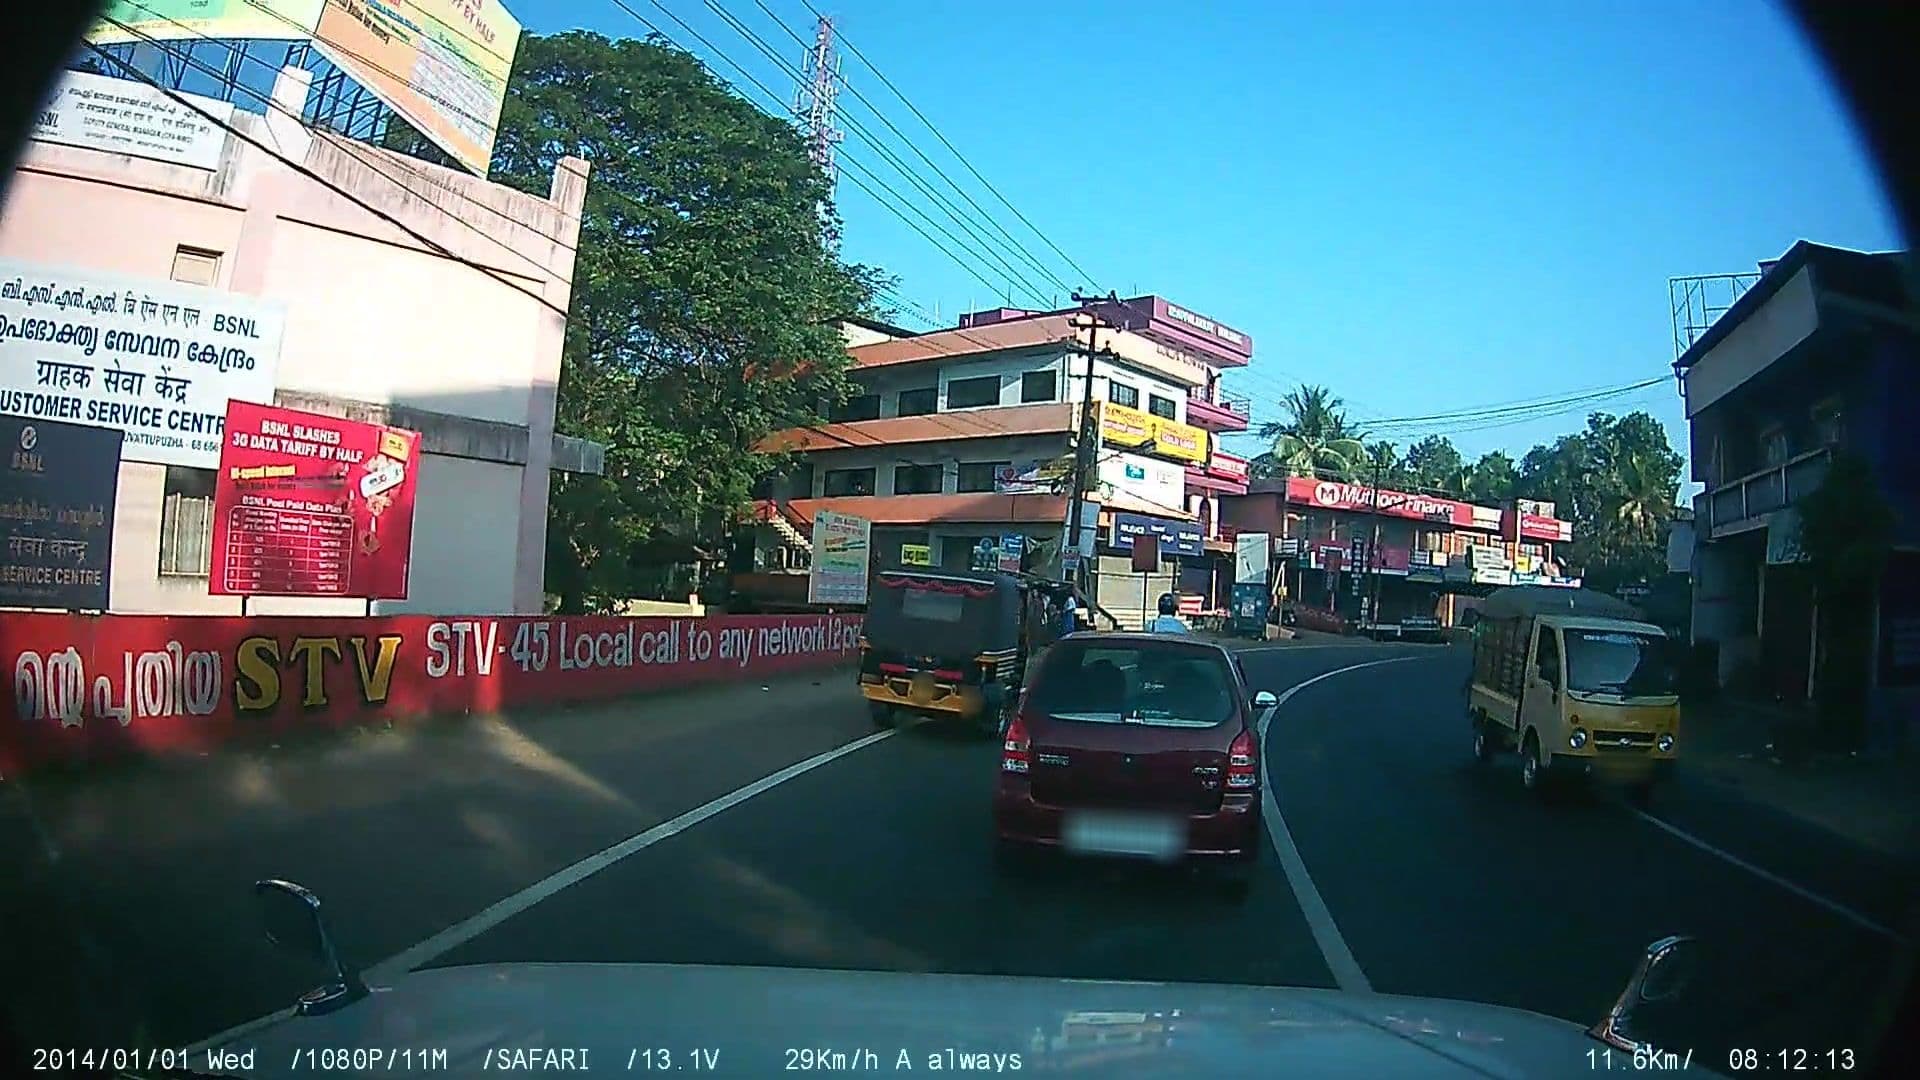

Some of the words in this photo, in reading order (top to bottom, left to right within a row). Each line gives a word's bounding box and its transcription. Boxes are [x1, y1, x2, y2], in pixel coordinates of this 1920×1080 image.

[213, 313, 260, 339] BSNL
[104, 329, 181, 360] സേവന
[36, 359, 94, 390] ग्राहक
[103, 358, 146, 397] सेवा
[155, 364, 192, 405] केंद्र
[87, 399, 163, 428] SERVICE
[260, 419, 291, 437] BSNL
[292, 425, 341, 445] SLASHES
[232, 432, 248, 447] 3G
[249, 435, 278, 452] DATA
[280, 438, 318, 457] TARIFF
[319, 446, 334, 460] BY
[335, 447, 364, 464] HALF
[55, 568, 102, 586] CENTRE
[560, 620, 634, 671] Local
[639, 620, 680, 664] call
[686, 622, 712, 662] to
[719, 627, 752, 668] any
[758, 618, 825, 655] network
[93, 640, 222, 727] പുതിയ
[234, 635, 403, 710] STV
